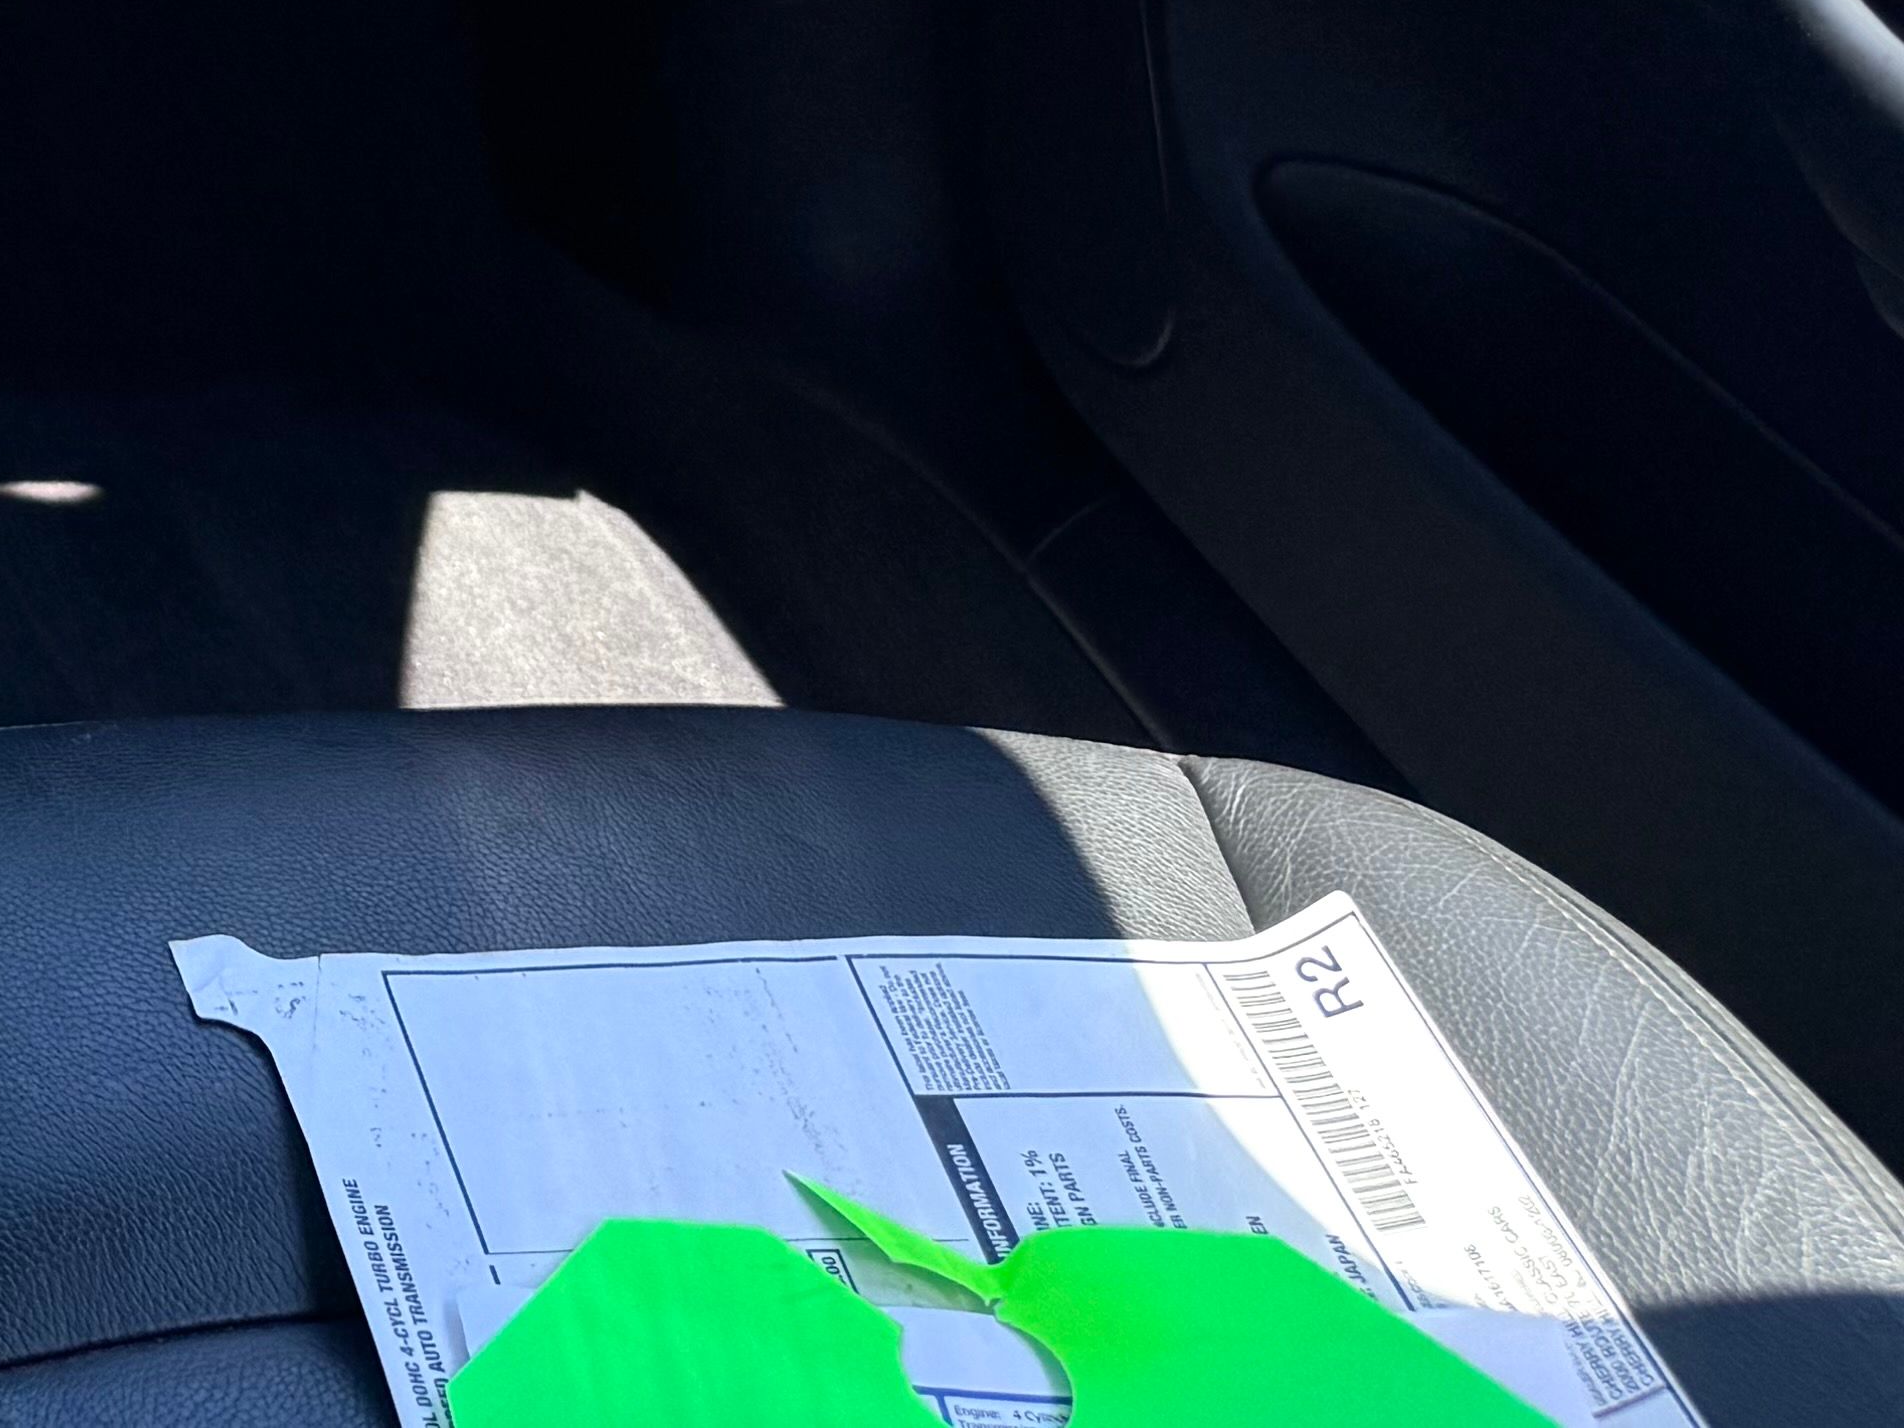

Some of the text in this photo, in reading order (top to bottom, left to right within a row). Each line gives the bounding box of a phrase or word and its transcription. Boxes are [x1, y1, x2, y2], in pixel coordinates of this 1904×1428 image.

[1295, 944, 1364, 1019] R2
[947, 1144, 1008, 1257] INFORMATION
[1021, 1149, 1072, 1228] TENT: 1%
[1049, 1153, 1086, 1204] PARTS
[1118, 1150, 1165, 1228] CLUDE FINAL
[1135, 1146, 1177, 1212] NON-PARTS
[1246, 1216, 1269, 1235] EN
[1488, 1206, 1519, 1244] CARS
[374, 1205, 446, 1372] AUTO TRANSMISSION
[1326, 1234, 1367, 1282] JAPAN
[343, 1178, 433, 1407] DOHC 4-CYCL TURBO ENGINE
[1579, 1311, 1615, 1358] ROUTE
[1608, 1323, 1654, 1387] CHERRY
[1576, 1341, 1623, 1401] CHERRY
